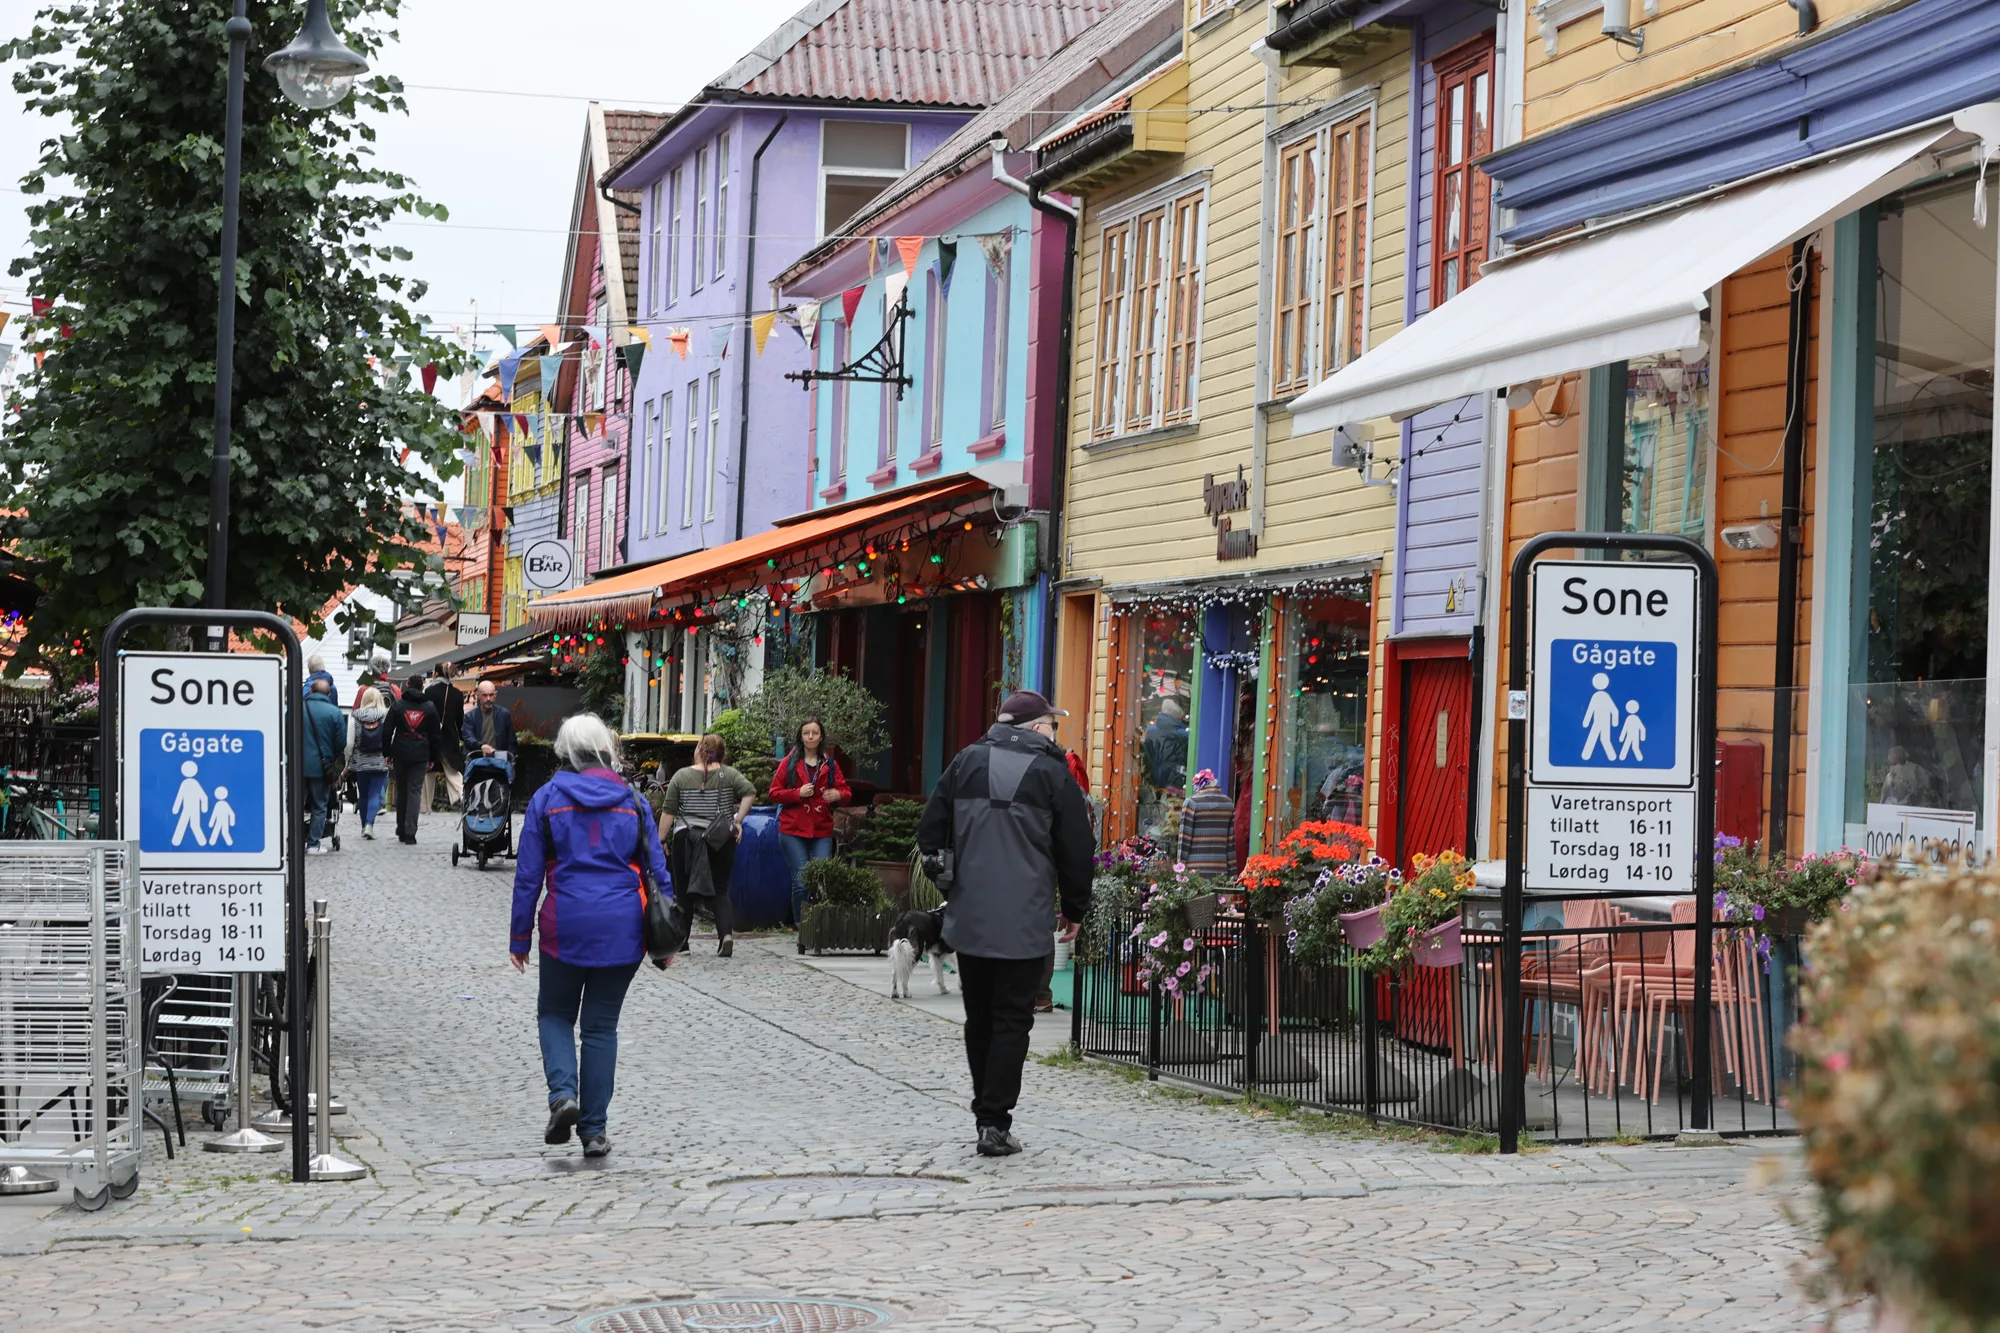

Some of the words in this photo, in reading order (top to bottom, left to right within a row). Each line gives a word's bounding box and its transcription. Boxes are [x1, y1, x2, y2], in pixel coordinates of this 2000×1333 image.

[1561, 576, 1669, 617] Sone
[459, 624, 488, 636] Finkel
[1572, 641, 1656, 670] Gågate
[150, 668, 255, 706] Sone
[160, 731, 244, 759] Gågate
[1551, 794, 1672, 816] Varetransport
[1550, 817, 1600, 834] tillatt
[1629, 819, 1671, 835] 16-11
[1550, 840, 1619, 861] Torsdag
[1629, 842, 1671, 858] 18-11
[1549, 863, 1609, 884] Lørdag
[1626, 864, 1673, 881] 14-10
[142, 880, 263, 899] Varetransport
[142, 902, 191, 918] tillatt
[221, 902, 262, 917] 16-11
[142, 924, 211, 944] Torsdag
[221, 924, 262, 939] 18-11
[142, 947, 201, 966] Lørdag
[218, 946, 265, 962] 14-10
